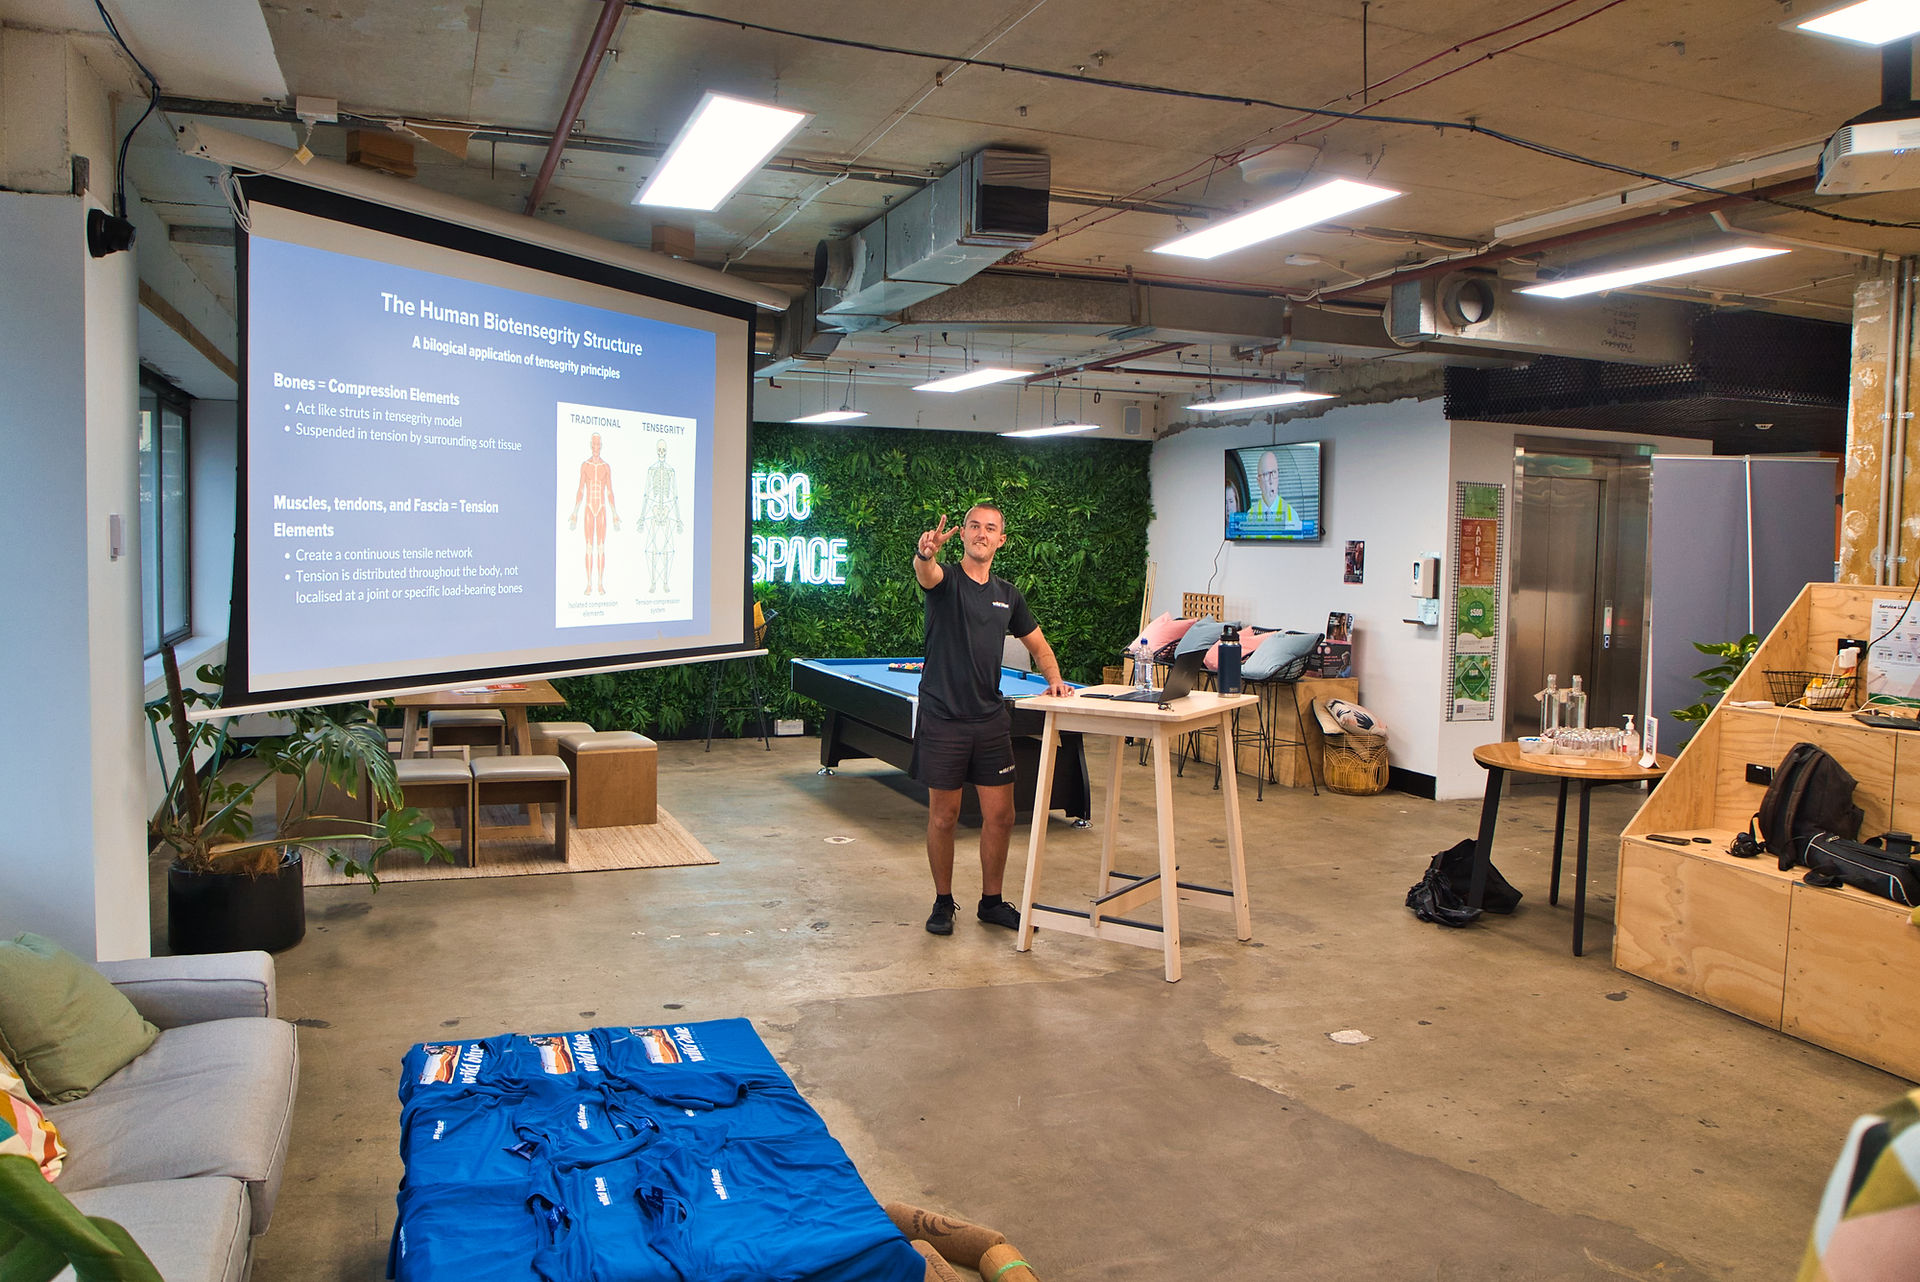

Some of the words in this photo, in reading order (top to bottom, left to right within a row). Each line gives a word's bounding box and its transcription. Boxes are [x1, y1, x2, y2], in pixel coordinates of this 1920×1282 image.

[381, 292, 416, 316] The
[420, 300, 479, 327] Human
[484, 311, 580, 348] Biotensegrity
[584, 331, 643, 356] Structure
[412, 336, 421, 348] A
[423, 338, 466, 356] bilogical
[468, 344, 522, 364] application
[524, 354, 534, 366] of
[535, 356, 579, 376] tensegrity
[581, 362, 620, 380] principles
[274, 372, 316, 390] Bones
[328, 378, 408, 400] Compression
[410, 388, 460, 406] Elements
[296, 402, 316, 416] Act
[318, 402, 336, 417] like
[340, 406, 370, 420] struts
[373, 406, 382, 420] in
[385, 407, 432, 427] tensegrity
[434, 414, 462, 428] model
[570, 414, 621, 428] TRADITIONAL
[296, 422, 354, 440] Suspended
[358, 425, 368, 440] in
[370, 427, 408, 442] tension
[410, 428, 422, 445] by
[424, 433, 478, 450] surrounding
[479, 436, 496, 450] soft
[498, 438, 522, 450] tissue
[642, 422, 685, 436] TENSEGRITY
[274, 495, 332, 512] Muscles,
[334, 497, 387, 514] tendons,
[390, 498, 412, 512] and
[414, 498, 449, 513] Fascia
[460, 500, 499, 514] Tension
[274, 522, 334, 538] Elements
[296, 548, 332, 562] Create
[335, 552, 342, 561] a
[344, 548, 400, 560] continuous
[402, 548, 433, 560] tensile
[436, 546, 473, 558] network
[752, 534, 848, 585] SPACE
[296, 568, 338, 582] Tension
[342, 568, 350, 582] is
[352, 567, 406, 581] distributed
[408, 566, 460, 580] throughout
[462, 566, 476, 578] the
[479, 565, 502, 579] body,
[504, 565, 518, 576] not
[296, 590, 342, 604] localised
[345, 590, 356, 602] at
[358, 592, 364, 601] a
[366, 588, 390, 602] joint
[392, 590, 402, 600] or
[404, 586, 440, 601] specific
[442, 584, 496, 598] load-bearing
[498, 582, 523, 594] bones
[572, 1034, 594, 1052] blue
[574, 1051, 600, 1072] wild
[458, 1062, 481, 1084] wild
